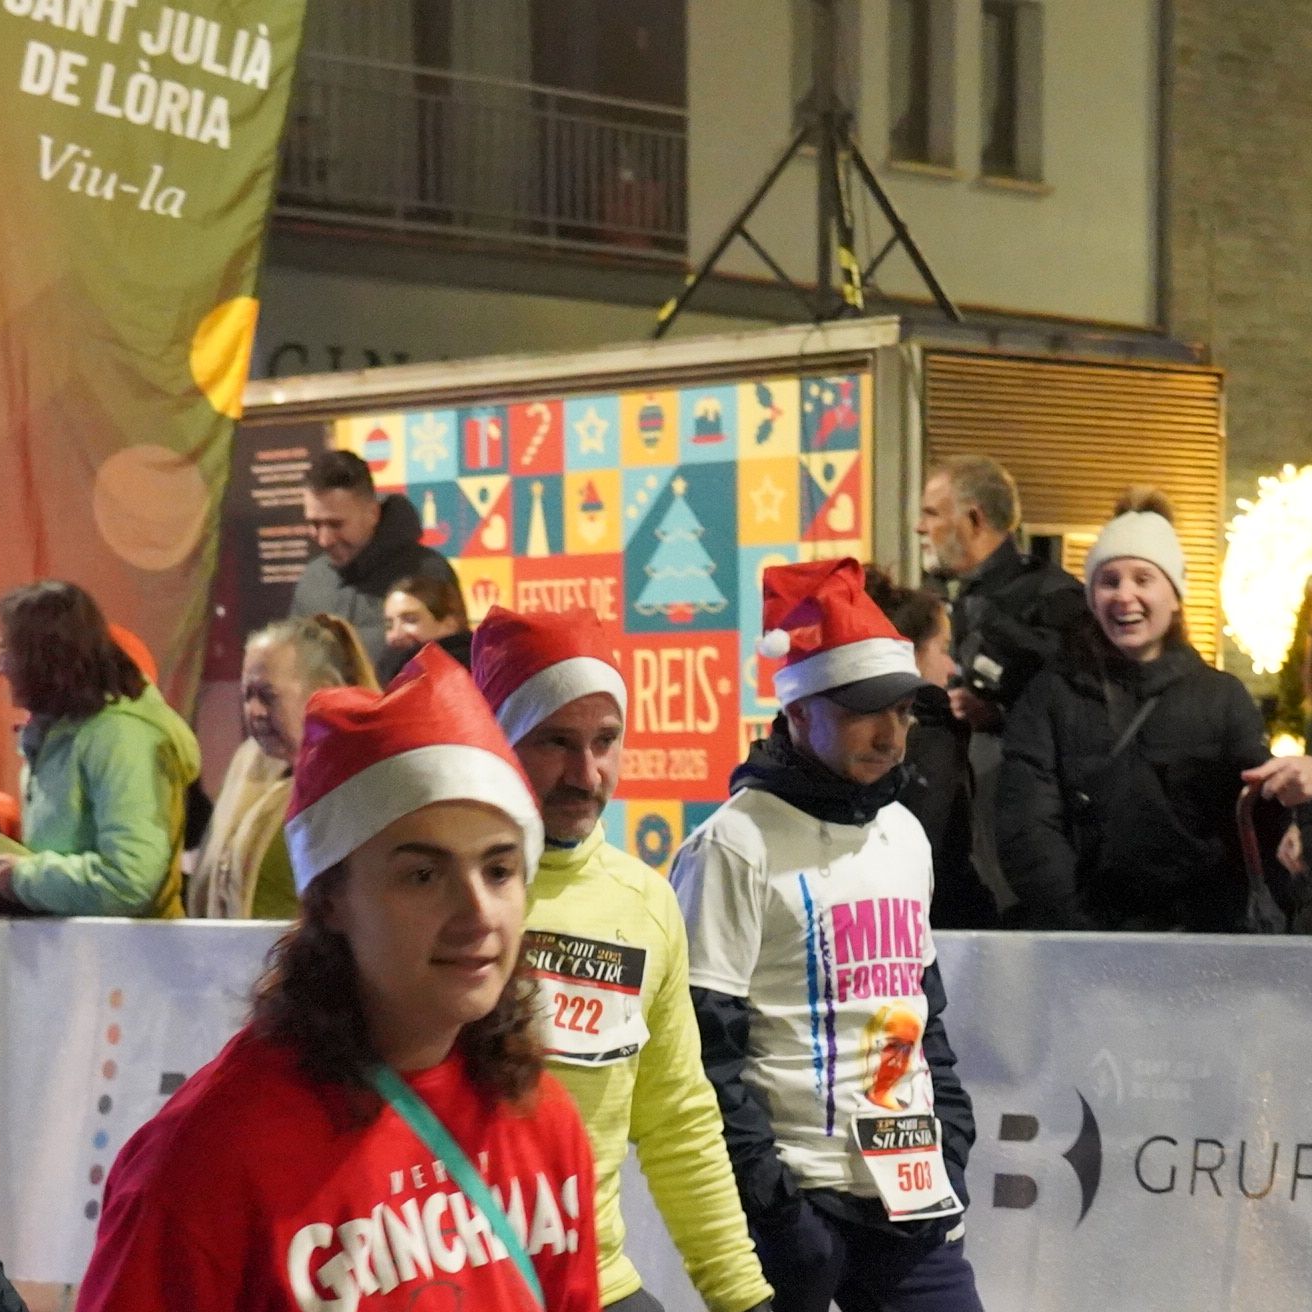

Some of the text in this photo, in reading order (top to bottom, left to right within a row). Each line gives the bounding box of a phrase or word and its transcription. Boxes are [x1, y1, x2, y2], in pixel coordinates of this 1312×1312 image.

[138, 7, 273, 90] JULIÀ
[19, 40, 231, 150] DE LÒRIA
[39, 134, 187, 219] Viu-la
[633, 646, 720, 734] REIS
[831, 897, 923, 966] MIKE
[554, 992, 605, 1035] 222
